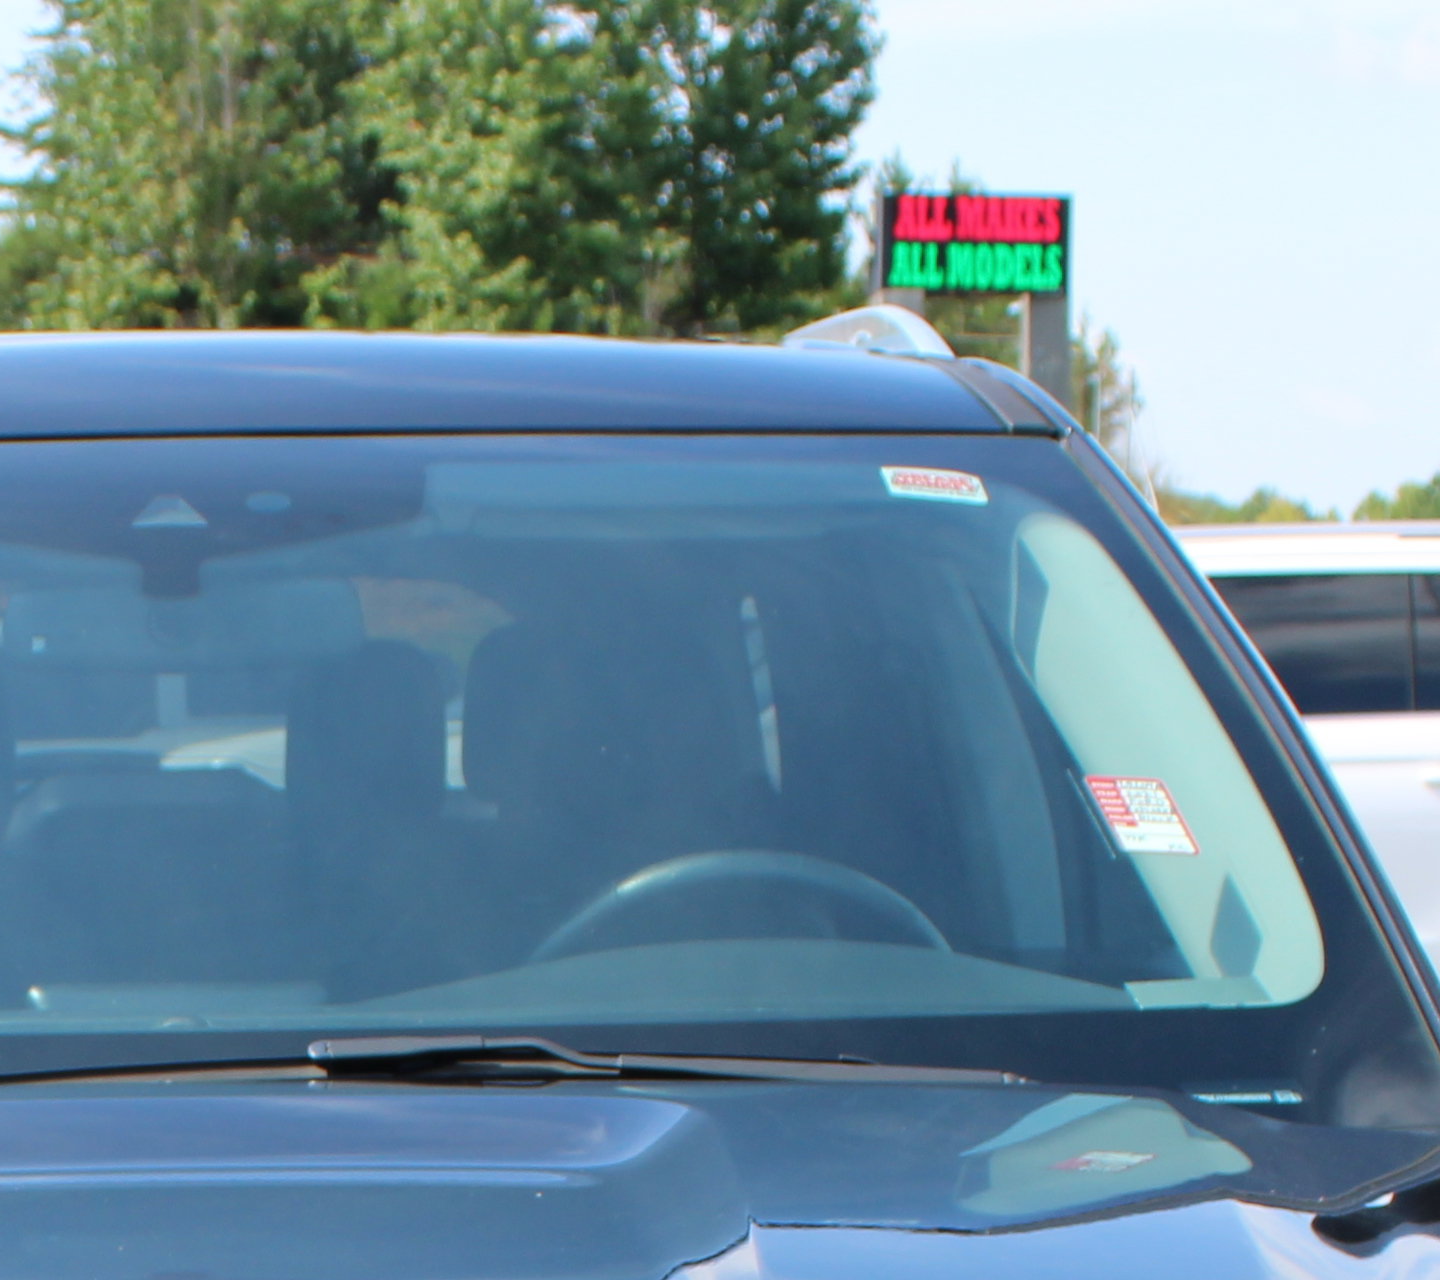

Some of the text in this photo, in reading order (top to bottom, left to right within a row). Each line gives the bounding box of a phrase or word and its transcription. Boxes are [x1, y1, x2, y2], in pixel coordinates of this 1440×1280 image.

[893, 194, 1062, 242] ALL MAKES
[888, 241, 1063, 290] ALL MODELS
